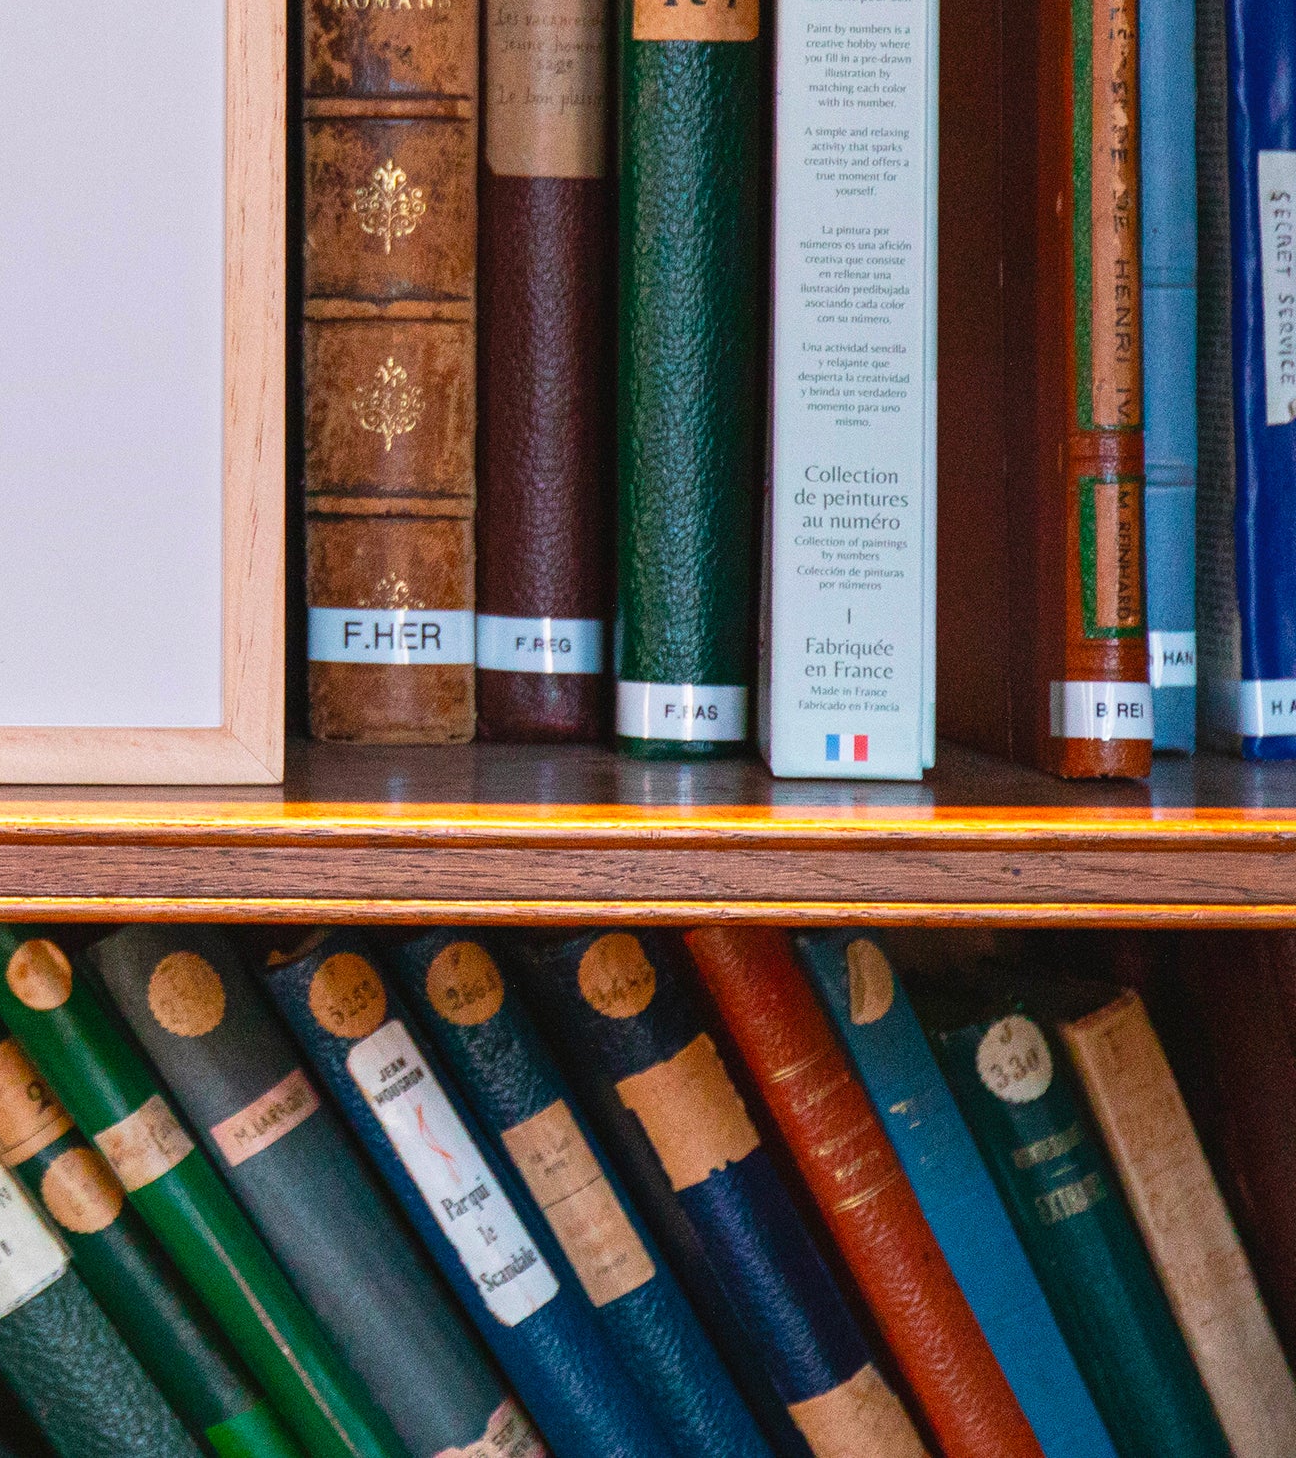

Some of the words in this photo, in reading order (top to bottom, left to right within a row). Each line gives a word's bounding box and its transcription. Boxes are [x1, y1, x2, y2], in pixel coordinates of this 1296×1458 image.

[1114, 259, 1133, 363] HENRI
[804, 465, 898, 484] Collection
[794, 487, 816, 505] de
[823, 491, 909, 510] peintures
[801, 515, 823, 529] au
[829, 513, 900, 531] numéro
[794, 536, 845, 547] Collection
[848, 536, 860, 547] of
[861, 538, 907, 549] paintings
[821, 550, 834, 561] by
[837, 551, 880, 561] numbers
[796, 565, 846, 577] Colección
[848, 567, 861, 577] de
[864, 568, 905, 579] pinturas
[819, 581, 835, 591] por
[838, 580, 882, 590] números
[343, 621, 442, 652] F.HER
[805, 637, 894, 659] Fabriquée
[804, 663, 826, 678] en
[833, 661, 894, 679] France
[810, 685, 840, 696] Made
[842, 686, 852, 696] in
[855, 687, 888, 698] France
[798, 700, 846, 712] Fabricado
[849, 702, 861, 711] en
[864, 701, 900, 713] Francia
[1117, 703, 1144, 720] REI
[476, 1225, 497, 1247] le
[479, 1246, 538, 1294] Scandale
